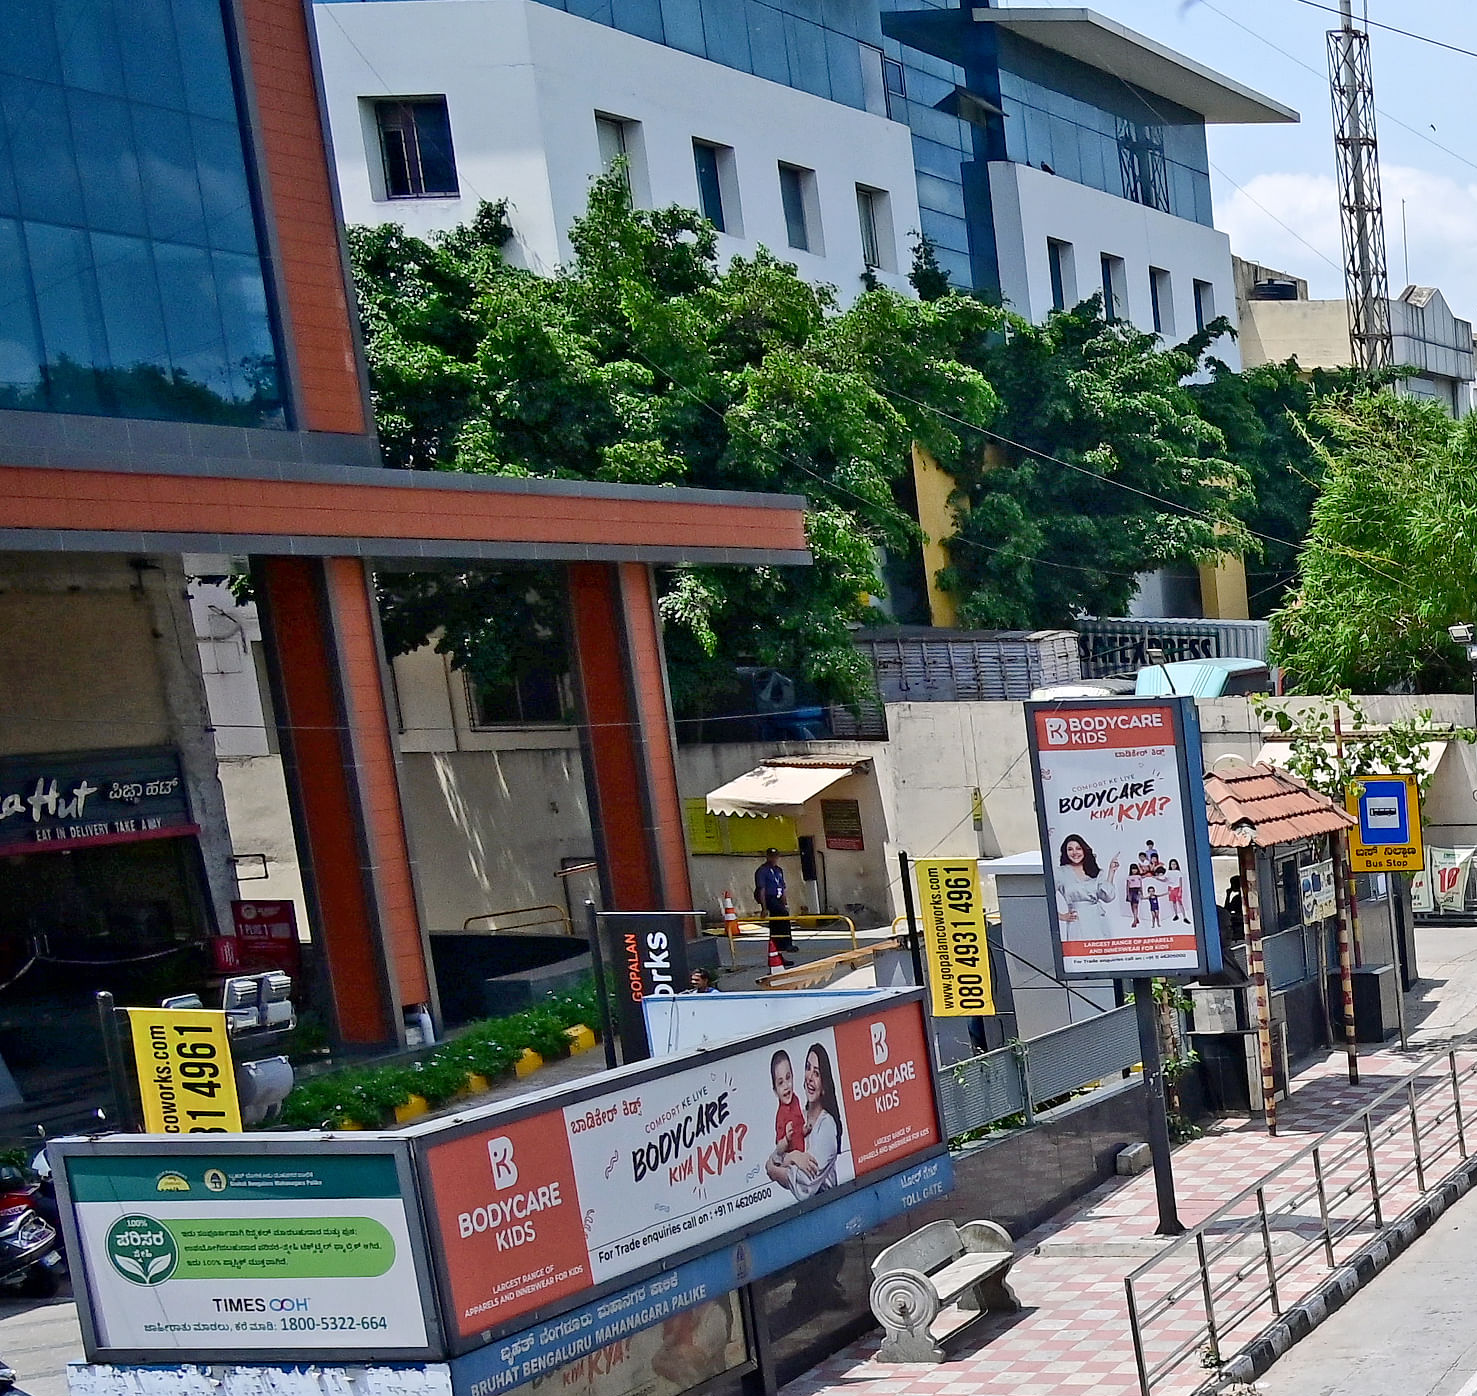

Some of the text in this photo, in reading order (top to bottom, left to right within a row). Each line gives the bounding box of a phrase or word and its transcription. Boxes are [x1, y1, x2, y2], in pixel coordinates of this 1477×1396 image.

[1070, 713, 1163, 731] BODYCARE
[1071, 731, 1108, 744] KIDS
[27, 777, 97, 822] Hut
[1058, 778, 1155, 814] BODYCARE
[1090, 796, 1172, 823] KIYA KYA?
[36, 820, 136, 842] EAT IN DELIVERY TAKE
[1355, 847, 1378, 857] ಬಸ್
[1365, 859, 1408, 869] Bus Stop
[927, 867, 955, 1009] www.gopalancoworks.com
[943, 866, 985, 1009] 080 4931 4961
[624, 933, 643, 1003] GOPALAN
[173, 1025, 222, 1098] 4961
[852, 1060, 916, 1101] BODYCARE
[571, 1103, 618, 1136] ಬಾಡಿಕೇರ್
[644, 1087, 709, 1134] COMFORT KE LIYE
[874, 1092, 900, 1114] KIDS
[632, 1091, 730, 1183] BODYCARE
[668, 1123, 749, 1187] KIYA KYA?
[457, 1181, 562, 1239] BODYCARE
[902, 1181, 943, 1209] TOLL GATE
[116, 1230, 165, 1247] ಪರಿಸರ
[127, 1219, 148, 1228] 100%
[495, 1220, 537, 1253] KIDS
[598, 1246, 614, 1263] For
[614, 1237, 641, 1259] Trade
[642, 1222, 681, 1247] enquiries
[682, 1215, 698, 1232] call
[713, 1205, 727, 1219] +91
[726, 1201, 735, 1213] 11
[734, 1187, 773, 1209] 46206000
[464, 1264, 584, 1318] APPARELS AND INNERWEAR FOR KIDS
[492, 1264, 555, 1295] LARGEST RANGE OF
[597, 1287, 646, 1318] ಮಹಾನಗರ
[650, 1270, 679, 1296] ಪಾಲಿಕೆ
[212, 1298, 266, 1313] TIMES
[234, 1319, 250, 1331] ಕರೆ
[280, 1316, 388, 1332] 1800-5322-664
[522, 1335, 593, 1379] BENGALURU
[595, 1303, 670, 1346] MAHANAGARA
[671, 1283, 707, 1311] PALIKE
